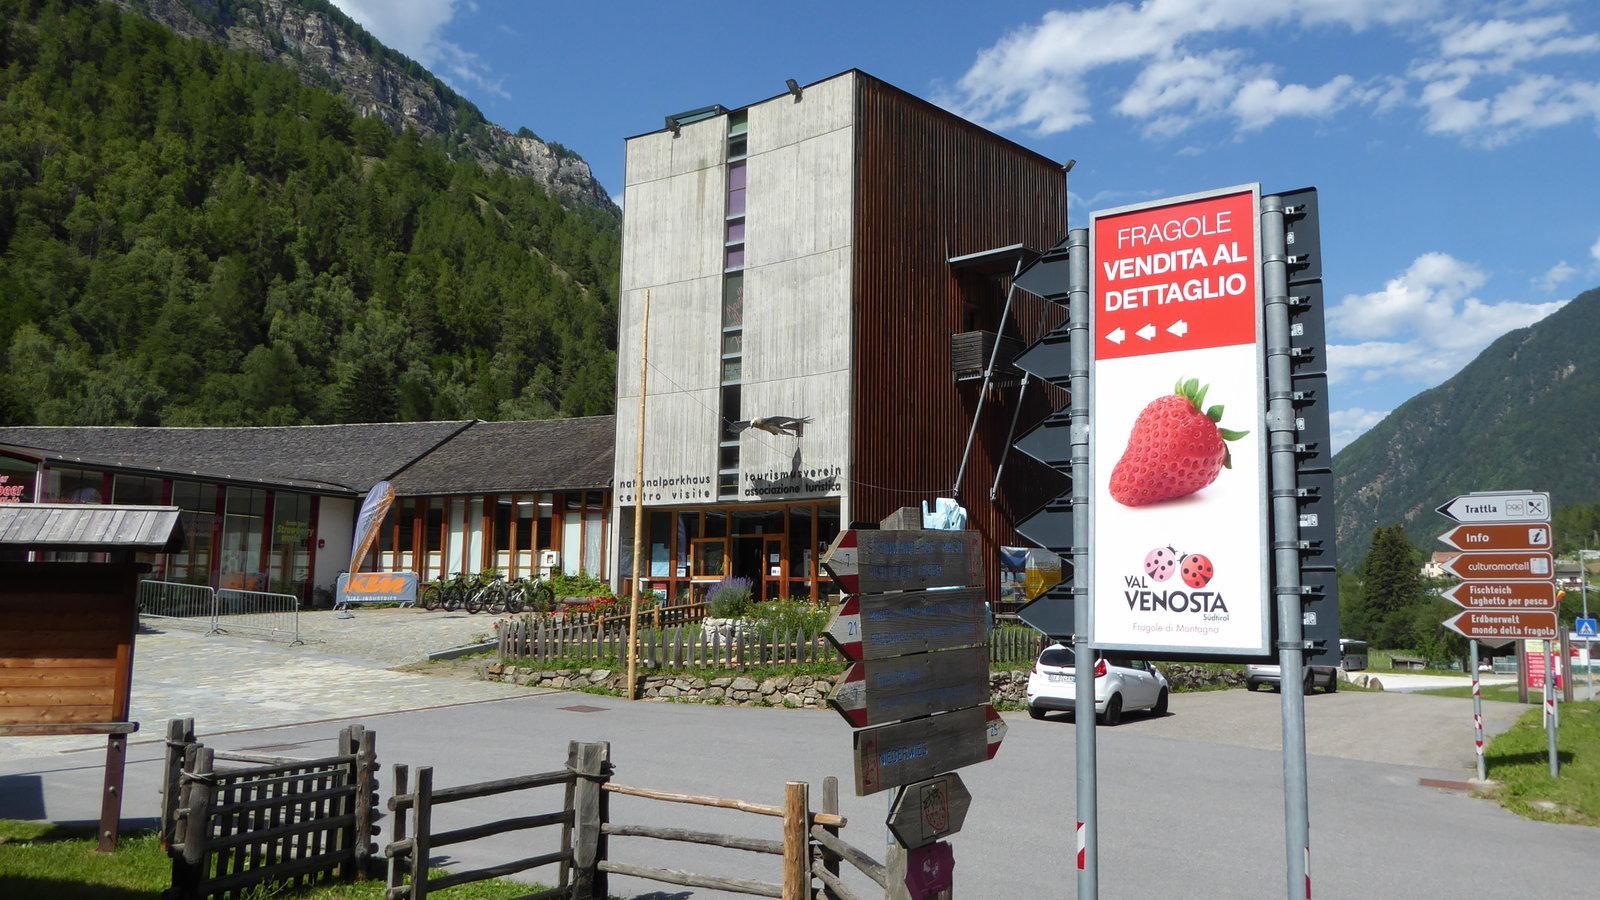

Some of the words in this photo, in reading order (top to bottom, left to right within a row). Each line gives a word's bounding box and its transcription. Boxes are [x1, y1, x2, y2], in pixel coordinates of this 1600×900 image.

[1117, 211, 1231, 249] FRAGOLE
[1103, 247, 1207, 281] VENDITA
[1212, 241, 1248, 265] AL
[1105, 273, 1247, 312] DETTAGLIO
[744, 464, 841, 481] tourismusverein
[672, 488, 710, 500] visite
[744, 484, 800, 497] associazione
[805, 481, 841, 493] turistica
[1465, 504, 1498, 514] Trattla
[1466, 533, 1490, 543] Info
[1124, 575, 1148, 588] VAL
[1469, 585, 1512, 595] Fischteich
[1124, 590, 1228, 613] VENOSTA
[1470, 597, 1506, 606] laghetto
[1508, 598, 1521, 606] per
[1524, 598, 1548, 606] pesca
[1203, 613, 1230, 622] Südtirol
[1471, 614, 1520, 624] Erdbeerwelt
[847, 621, 858, 636] 21
[1132, 622, 1164, 635] Fragole
[1165, 623, 1173, 633] di
[1176, 623, 1219, 636] Montagna
[1472, 626, 1498, 635] mondo
[1500, 626, 1522, 635] della
[1524, 626, 1555, 637] fragola
